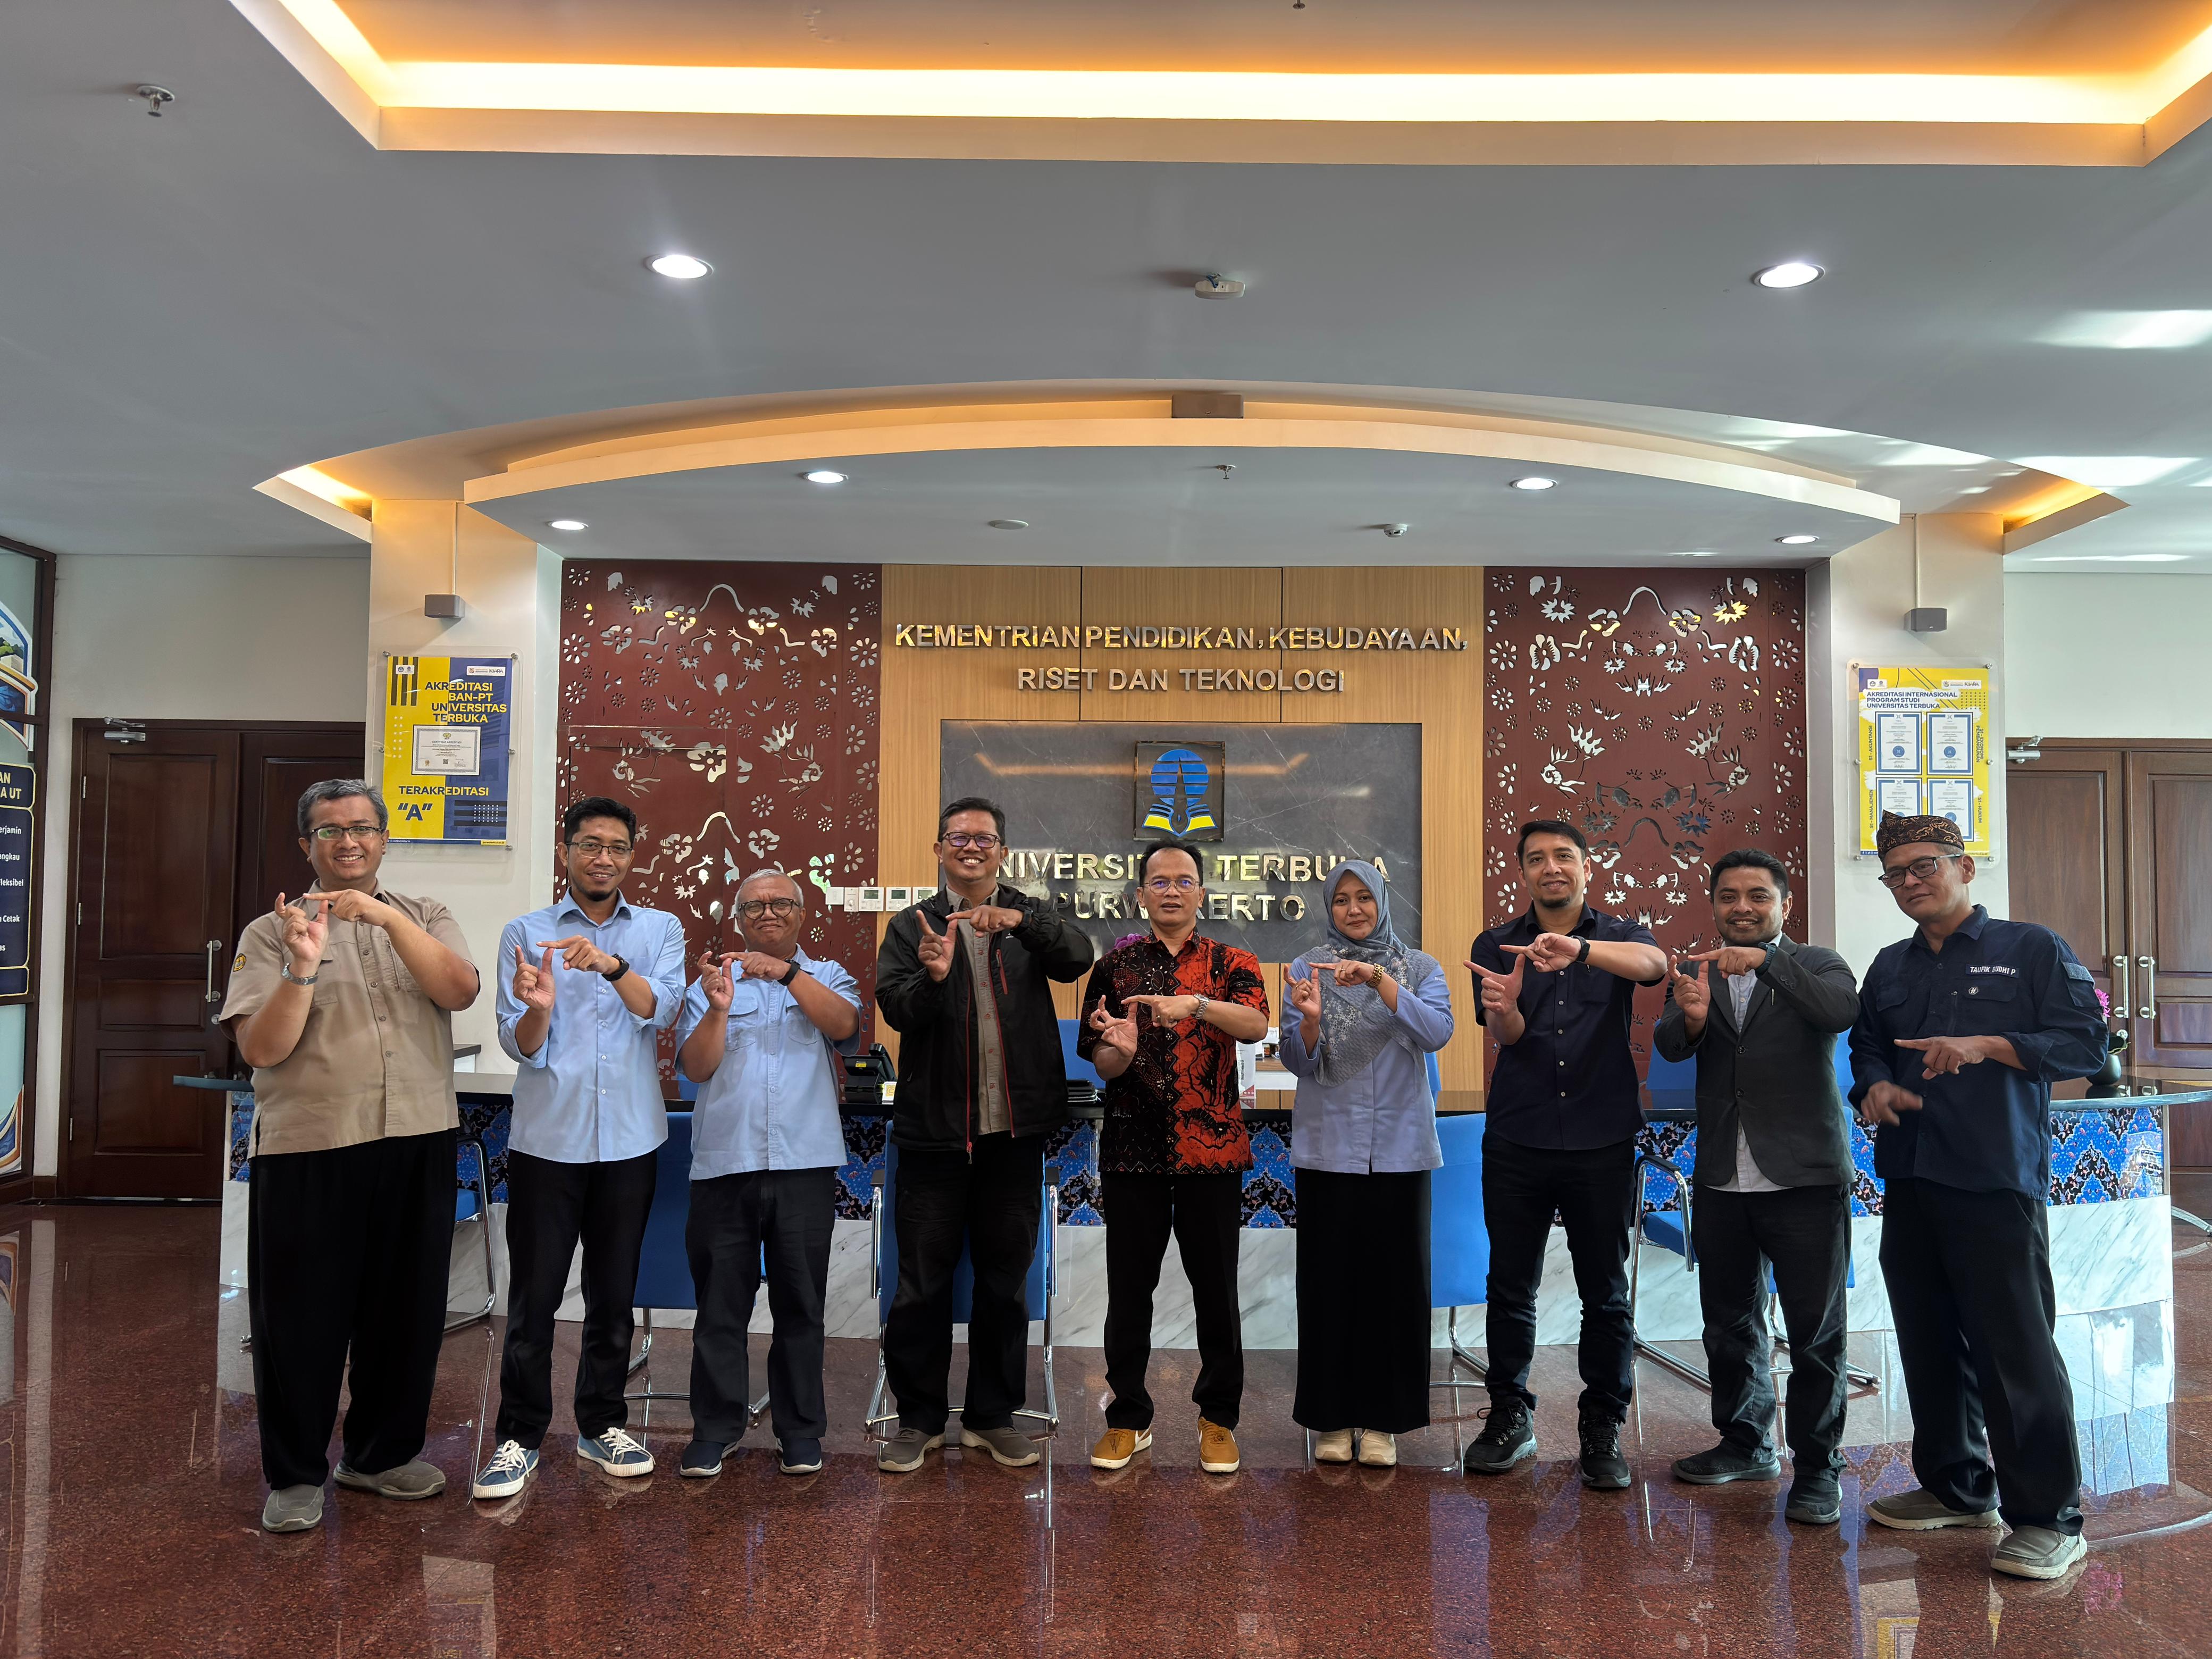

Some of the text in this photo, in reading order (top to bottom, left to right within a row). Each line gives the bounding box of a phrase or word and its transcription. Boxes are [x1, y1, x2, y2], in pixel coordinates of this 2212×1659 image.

[895, 624, 1468, 651] KEMENTRIAN PENDIDIKAN, KEBUDAYAAN,
[1018, 668, 1344, 692] RISET DAN TEKNOLOGI
[425, 681, 493, 691] AKREDITASI
[448, 692, 493, 702] BAN-PT
[431, 702, 507, 713] UNIVERSITAS
[433, 713, 489, 723] TERBUKA
[9, 787, 22, 800] UT
[399, 785, 489, 796] TERAKREDITASI
[1217, 855, 1392, 882] TERBUA
[0, 878, 24, 886] leksibel
[1052, 892, 1305, 921] PURWERTO
[1992, 966, 2010, 974] BUDHI
